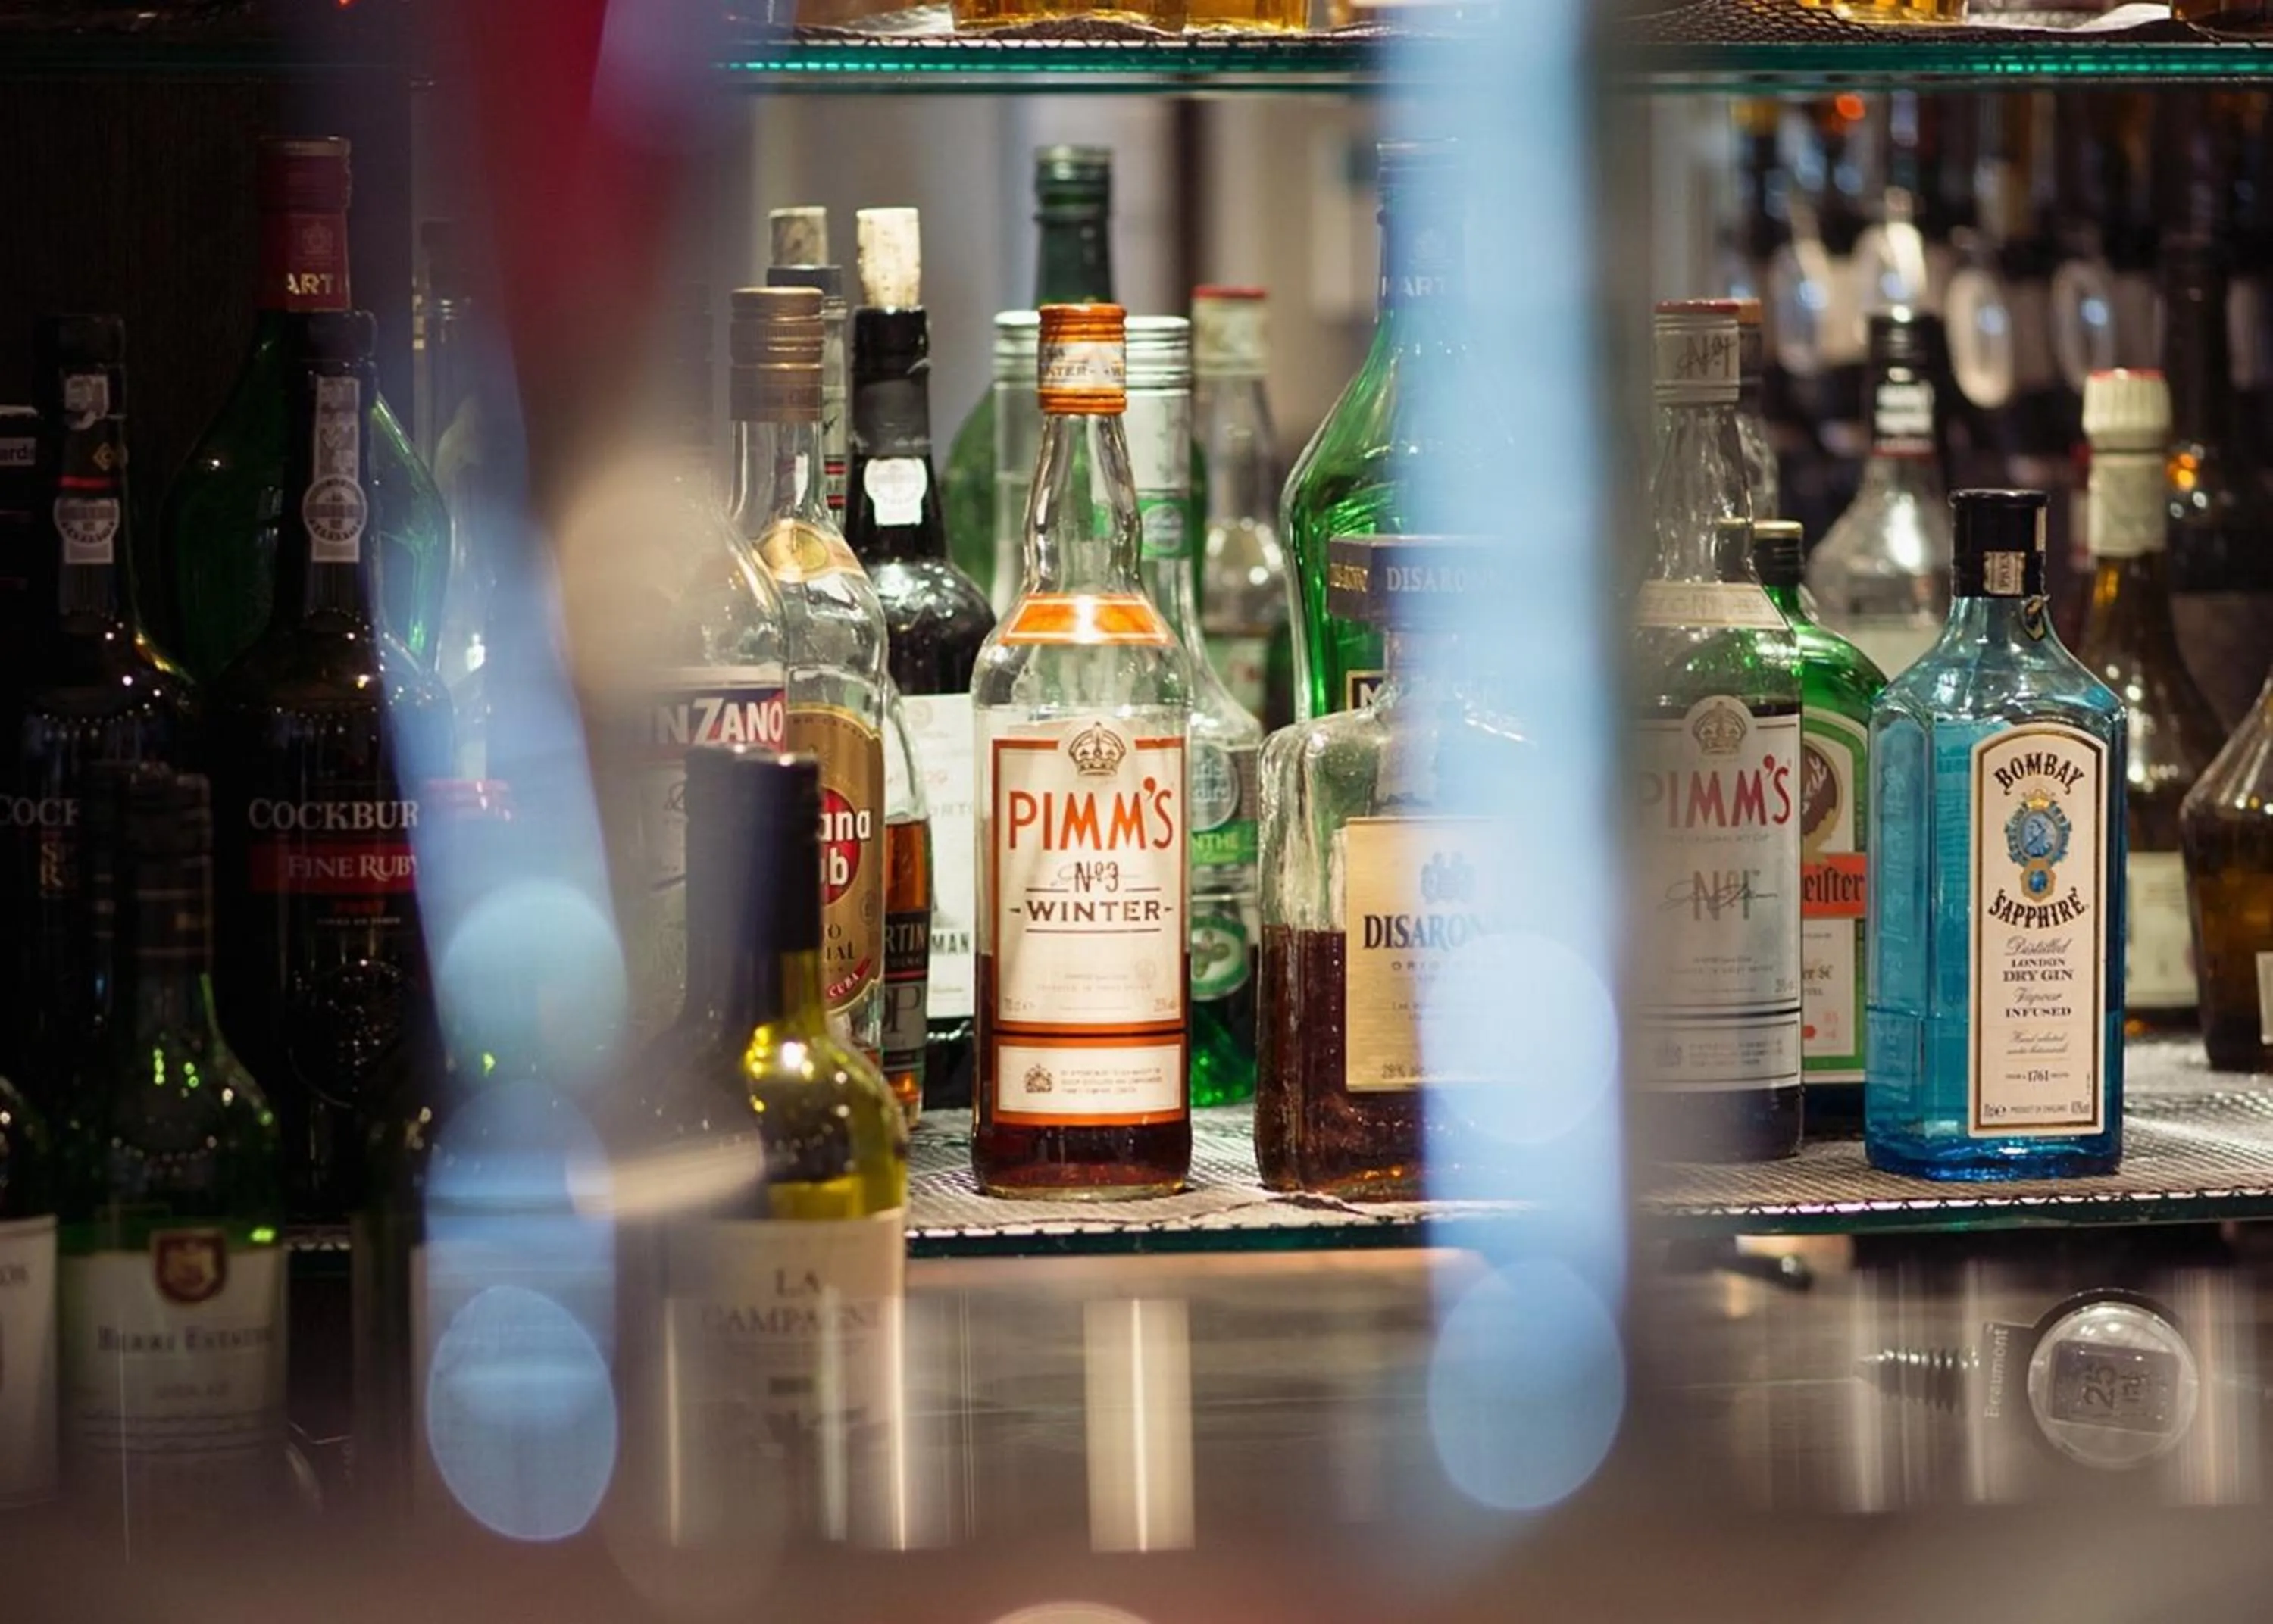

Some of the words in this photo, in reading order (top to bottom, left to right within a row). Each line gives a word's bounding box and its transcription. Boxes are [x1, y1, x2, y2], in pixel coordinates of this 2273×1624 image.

[1993, 751, 2085, 796] BOMBAY
[1634, 754, 1791, 829] PIMM'S
[1008, 776, 1174, 851] PIMM'S
[288, 854, 355, 879] FINE
[1025, 899, 1161, 922] WINTER
[1987, 886, 2086, 929] SAPPHIRE
[2004, 935, 2073, 957] Distilled
[2011, 957, 2066, 968] LONDON
[2002, 970, 2038, 982] DRY
[2040, 969, 2074, 982] GIN
[2005, 1008, 2073, 1019] INFUSED
[1984, 1328, 2009, 1419] Beaumont
